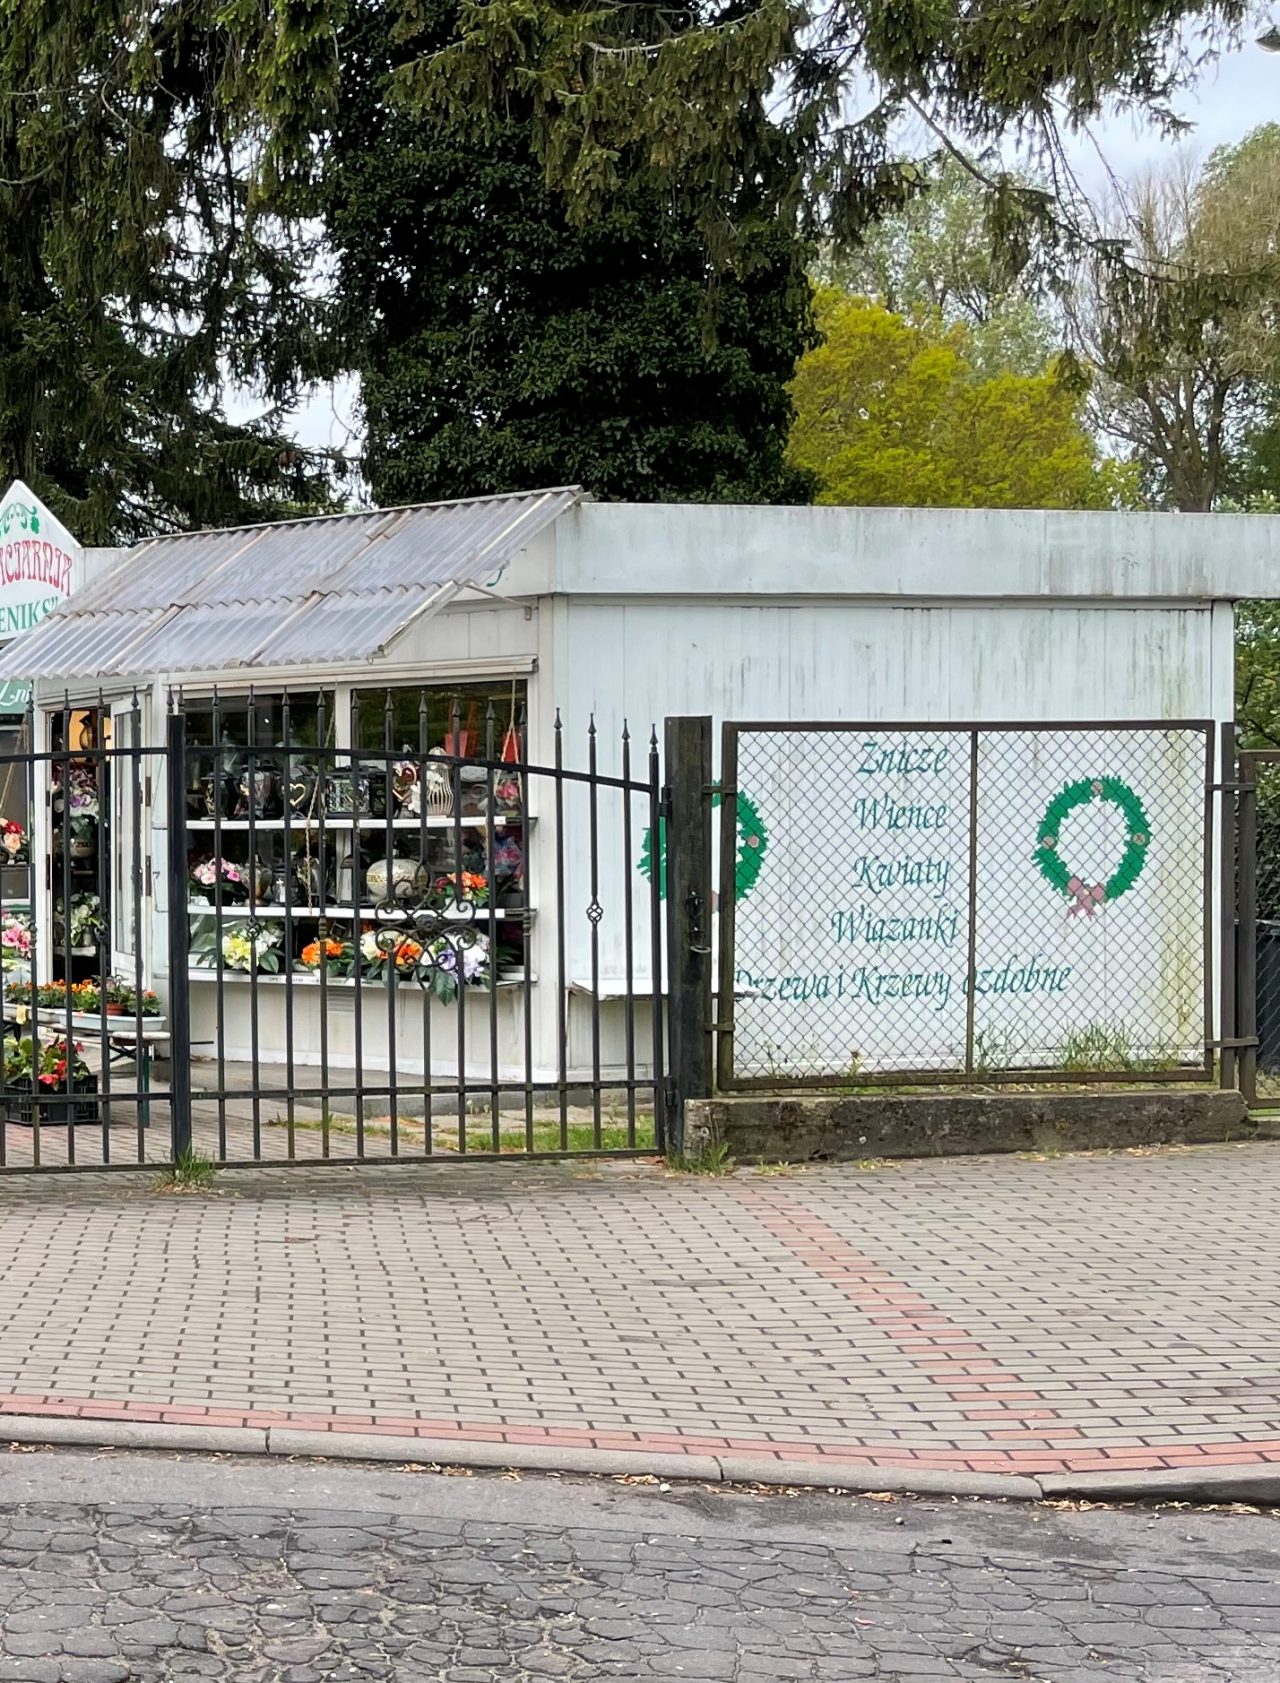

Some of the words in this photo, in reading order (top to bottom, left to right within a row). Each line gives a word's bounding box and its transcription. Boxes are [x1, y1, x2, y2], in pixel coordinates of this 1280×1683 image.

[856, 741, 948, 774] Znicze
[853, 792, 946, 830] Wieńce
[851, 855, 951, 899] Kwiaty
[831, 903, 959, 952] Wiązanki
[838, 963, 845, 998] i
[851, 965, 952, 1011] Krzewy
